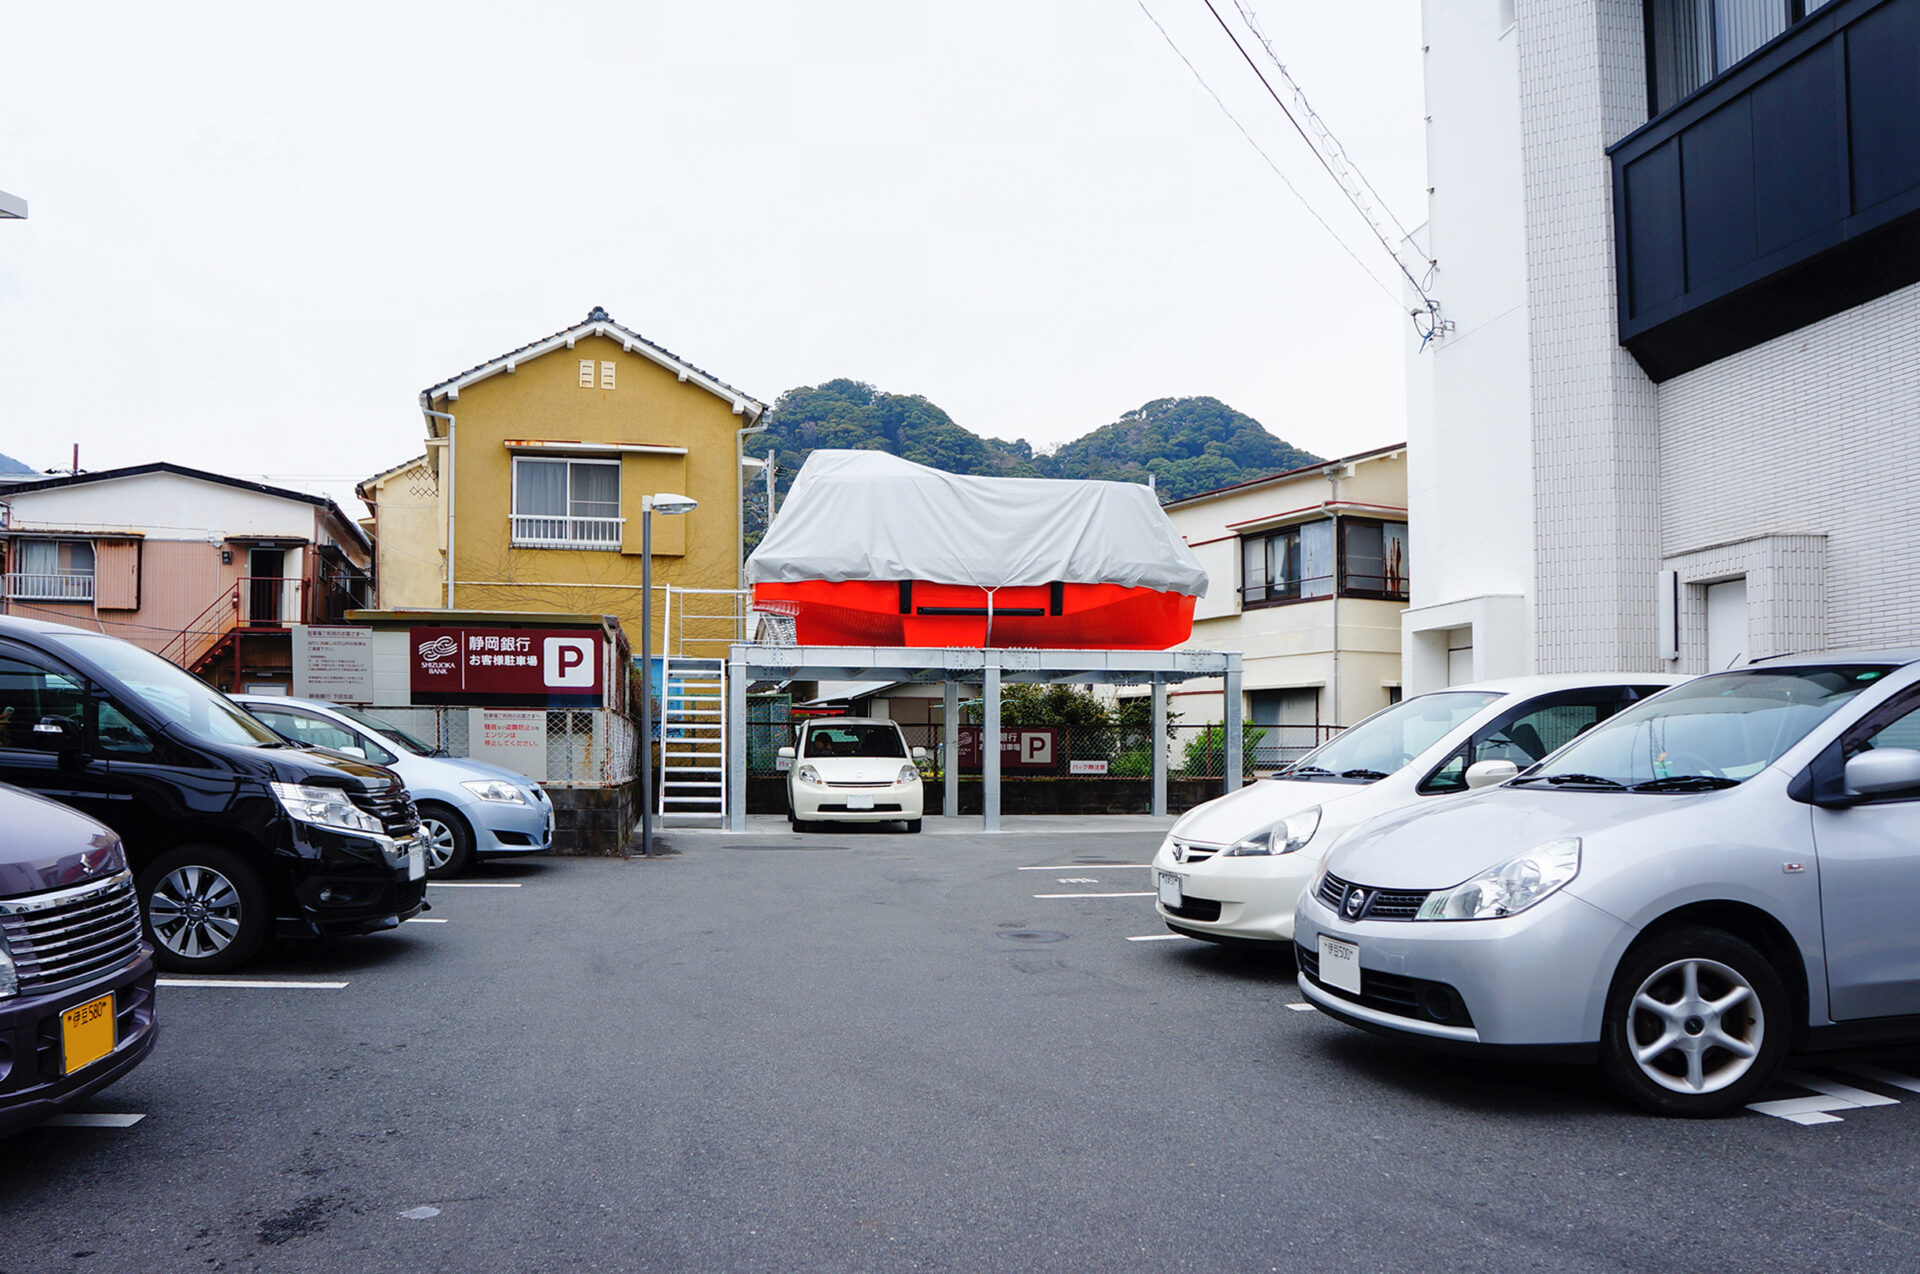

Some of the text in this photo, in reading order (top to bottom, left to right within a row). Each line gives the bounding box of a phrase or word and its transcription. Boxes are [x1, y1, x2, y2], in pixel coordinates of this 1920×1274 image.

[469, 636, 531, 652] 静岡銀行
[421, 661, 456, 669] SHIZUOKA
[469, 654, 538, 667] お客様駐車場
[558, 645, 584, 678] P
[1029, 736, 1046, 759] P
[73, 1001, 103, 1028] 伊豆580
